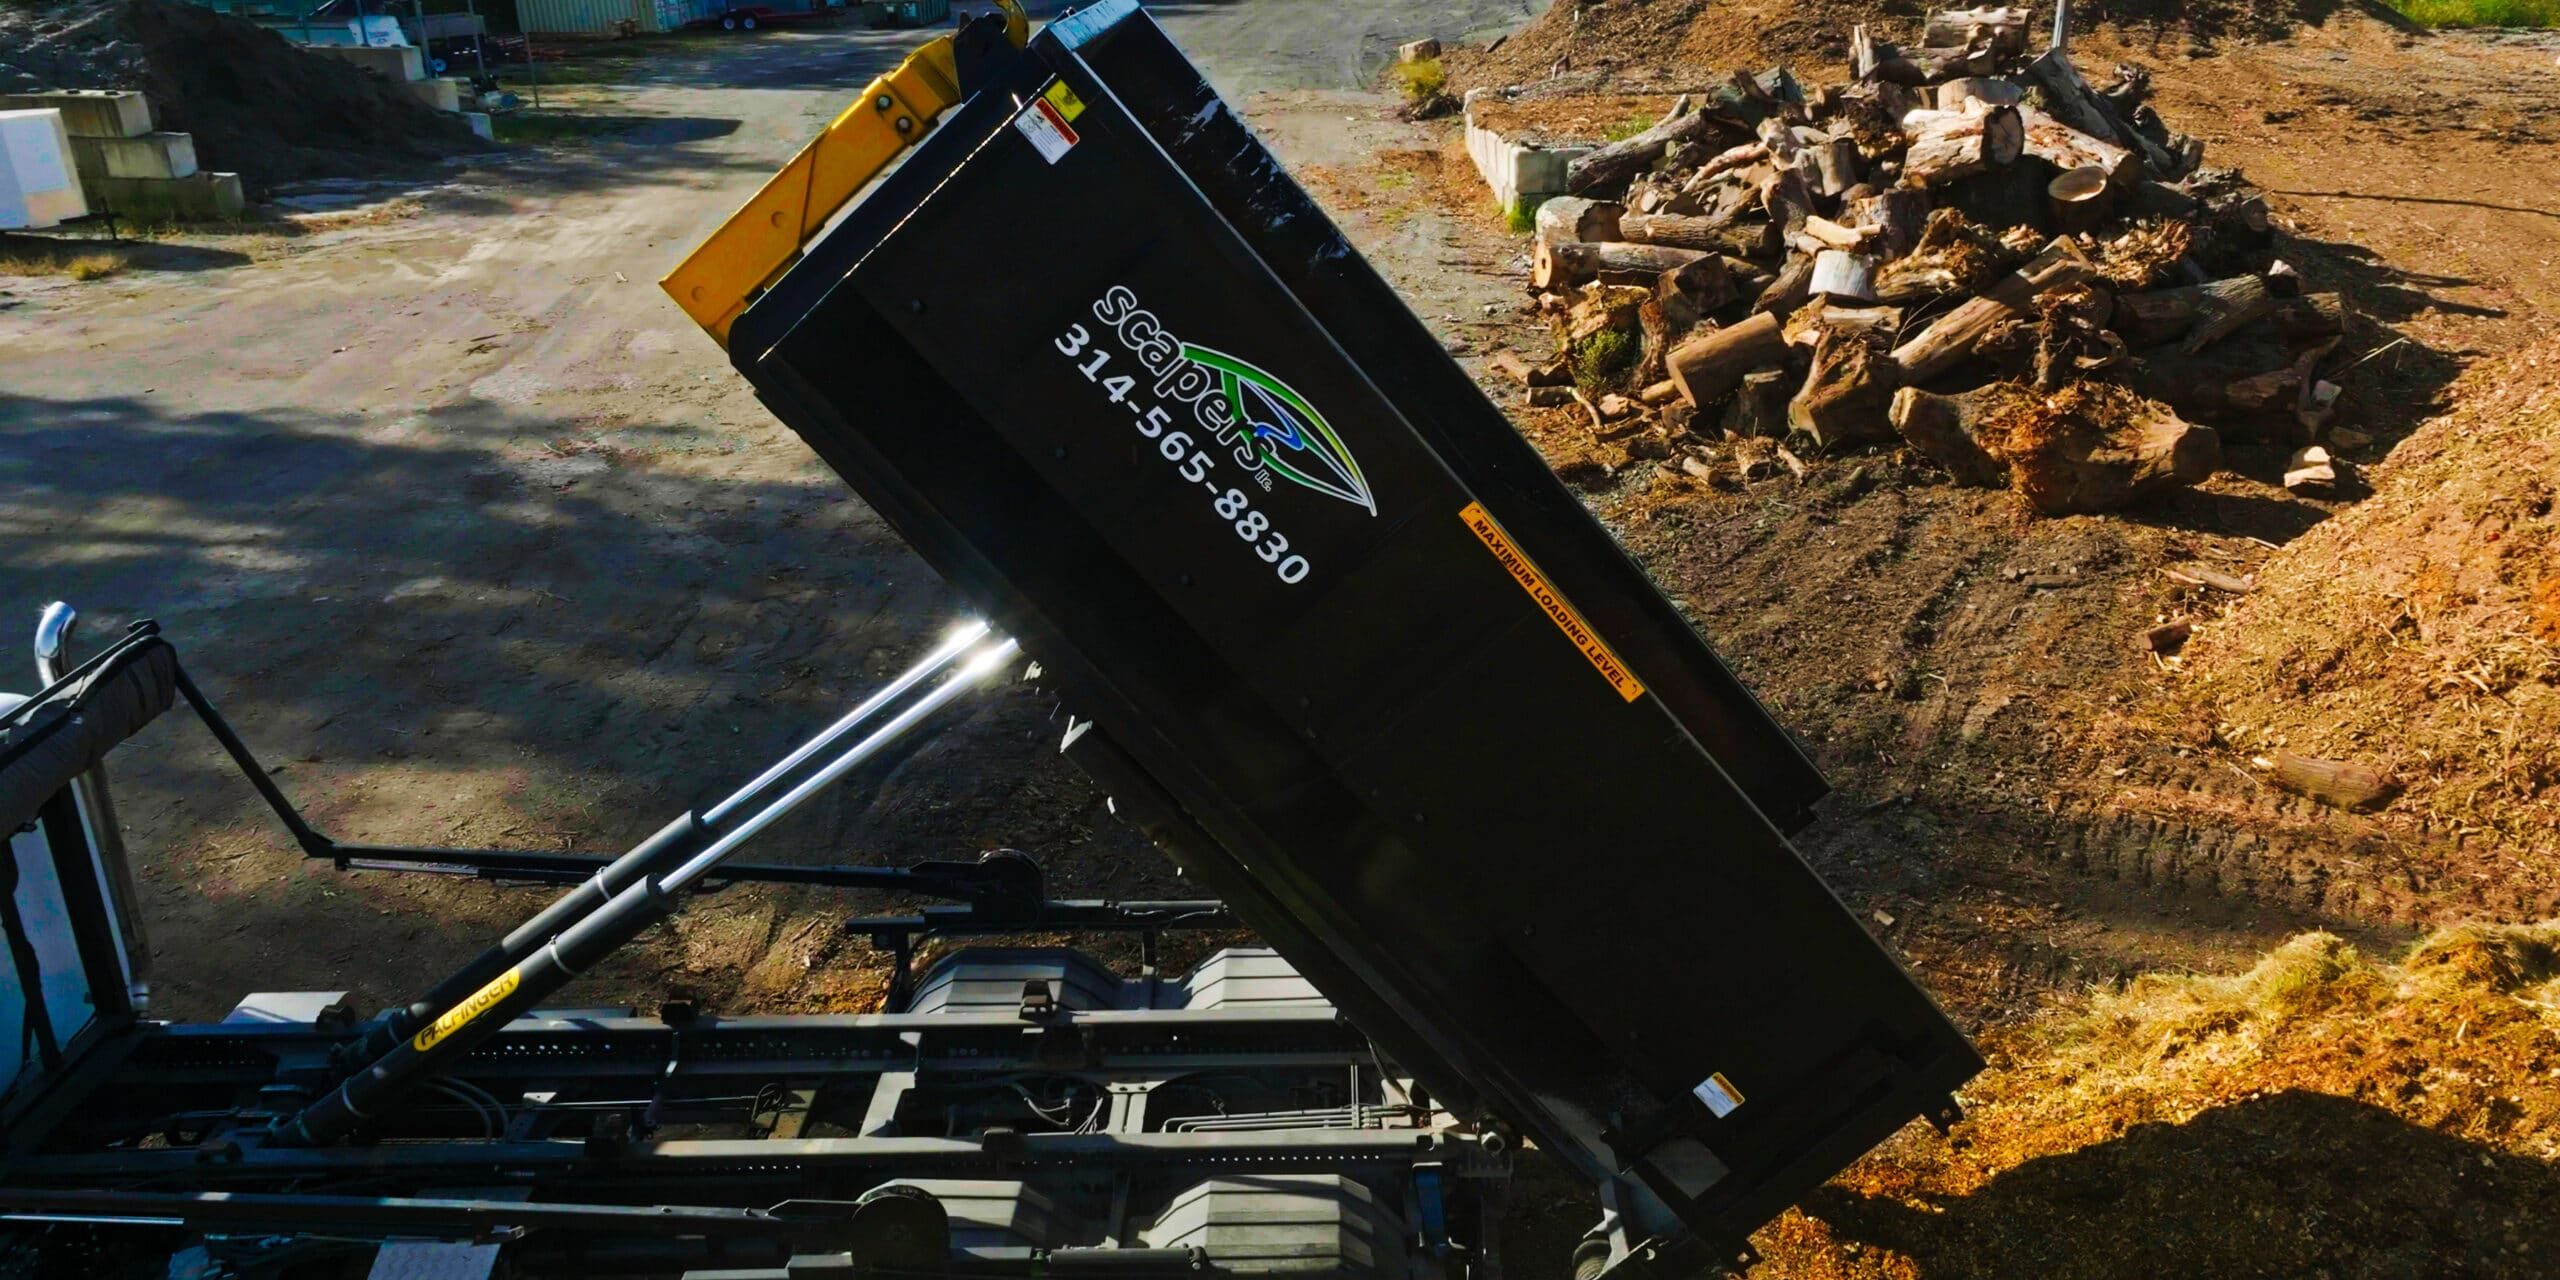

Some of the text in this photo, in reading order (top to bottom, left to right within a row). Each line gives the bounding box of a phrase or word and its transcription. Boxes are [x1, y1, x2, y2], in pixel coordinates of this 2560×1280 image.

[1054, 323, 1310, 584] 314-565-8830
[1473, 519, 1625, 689] MAXIMUM LOADING LEVEL
[420, 974, 514, 1046] PALFINGER
